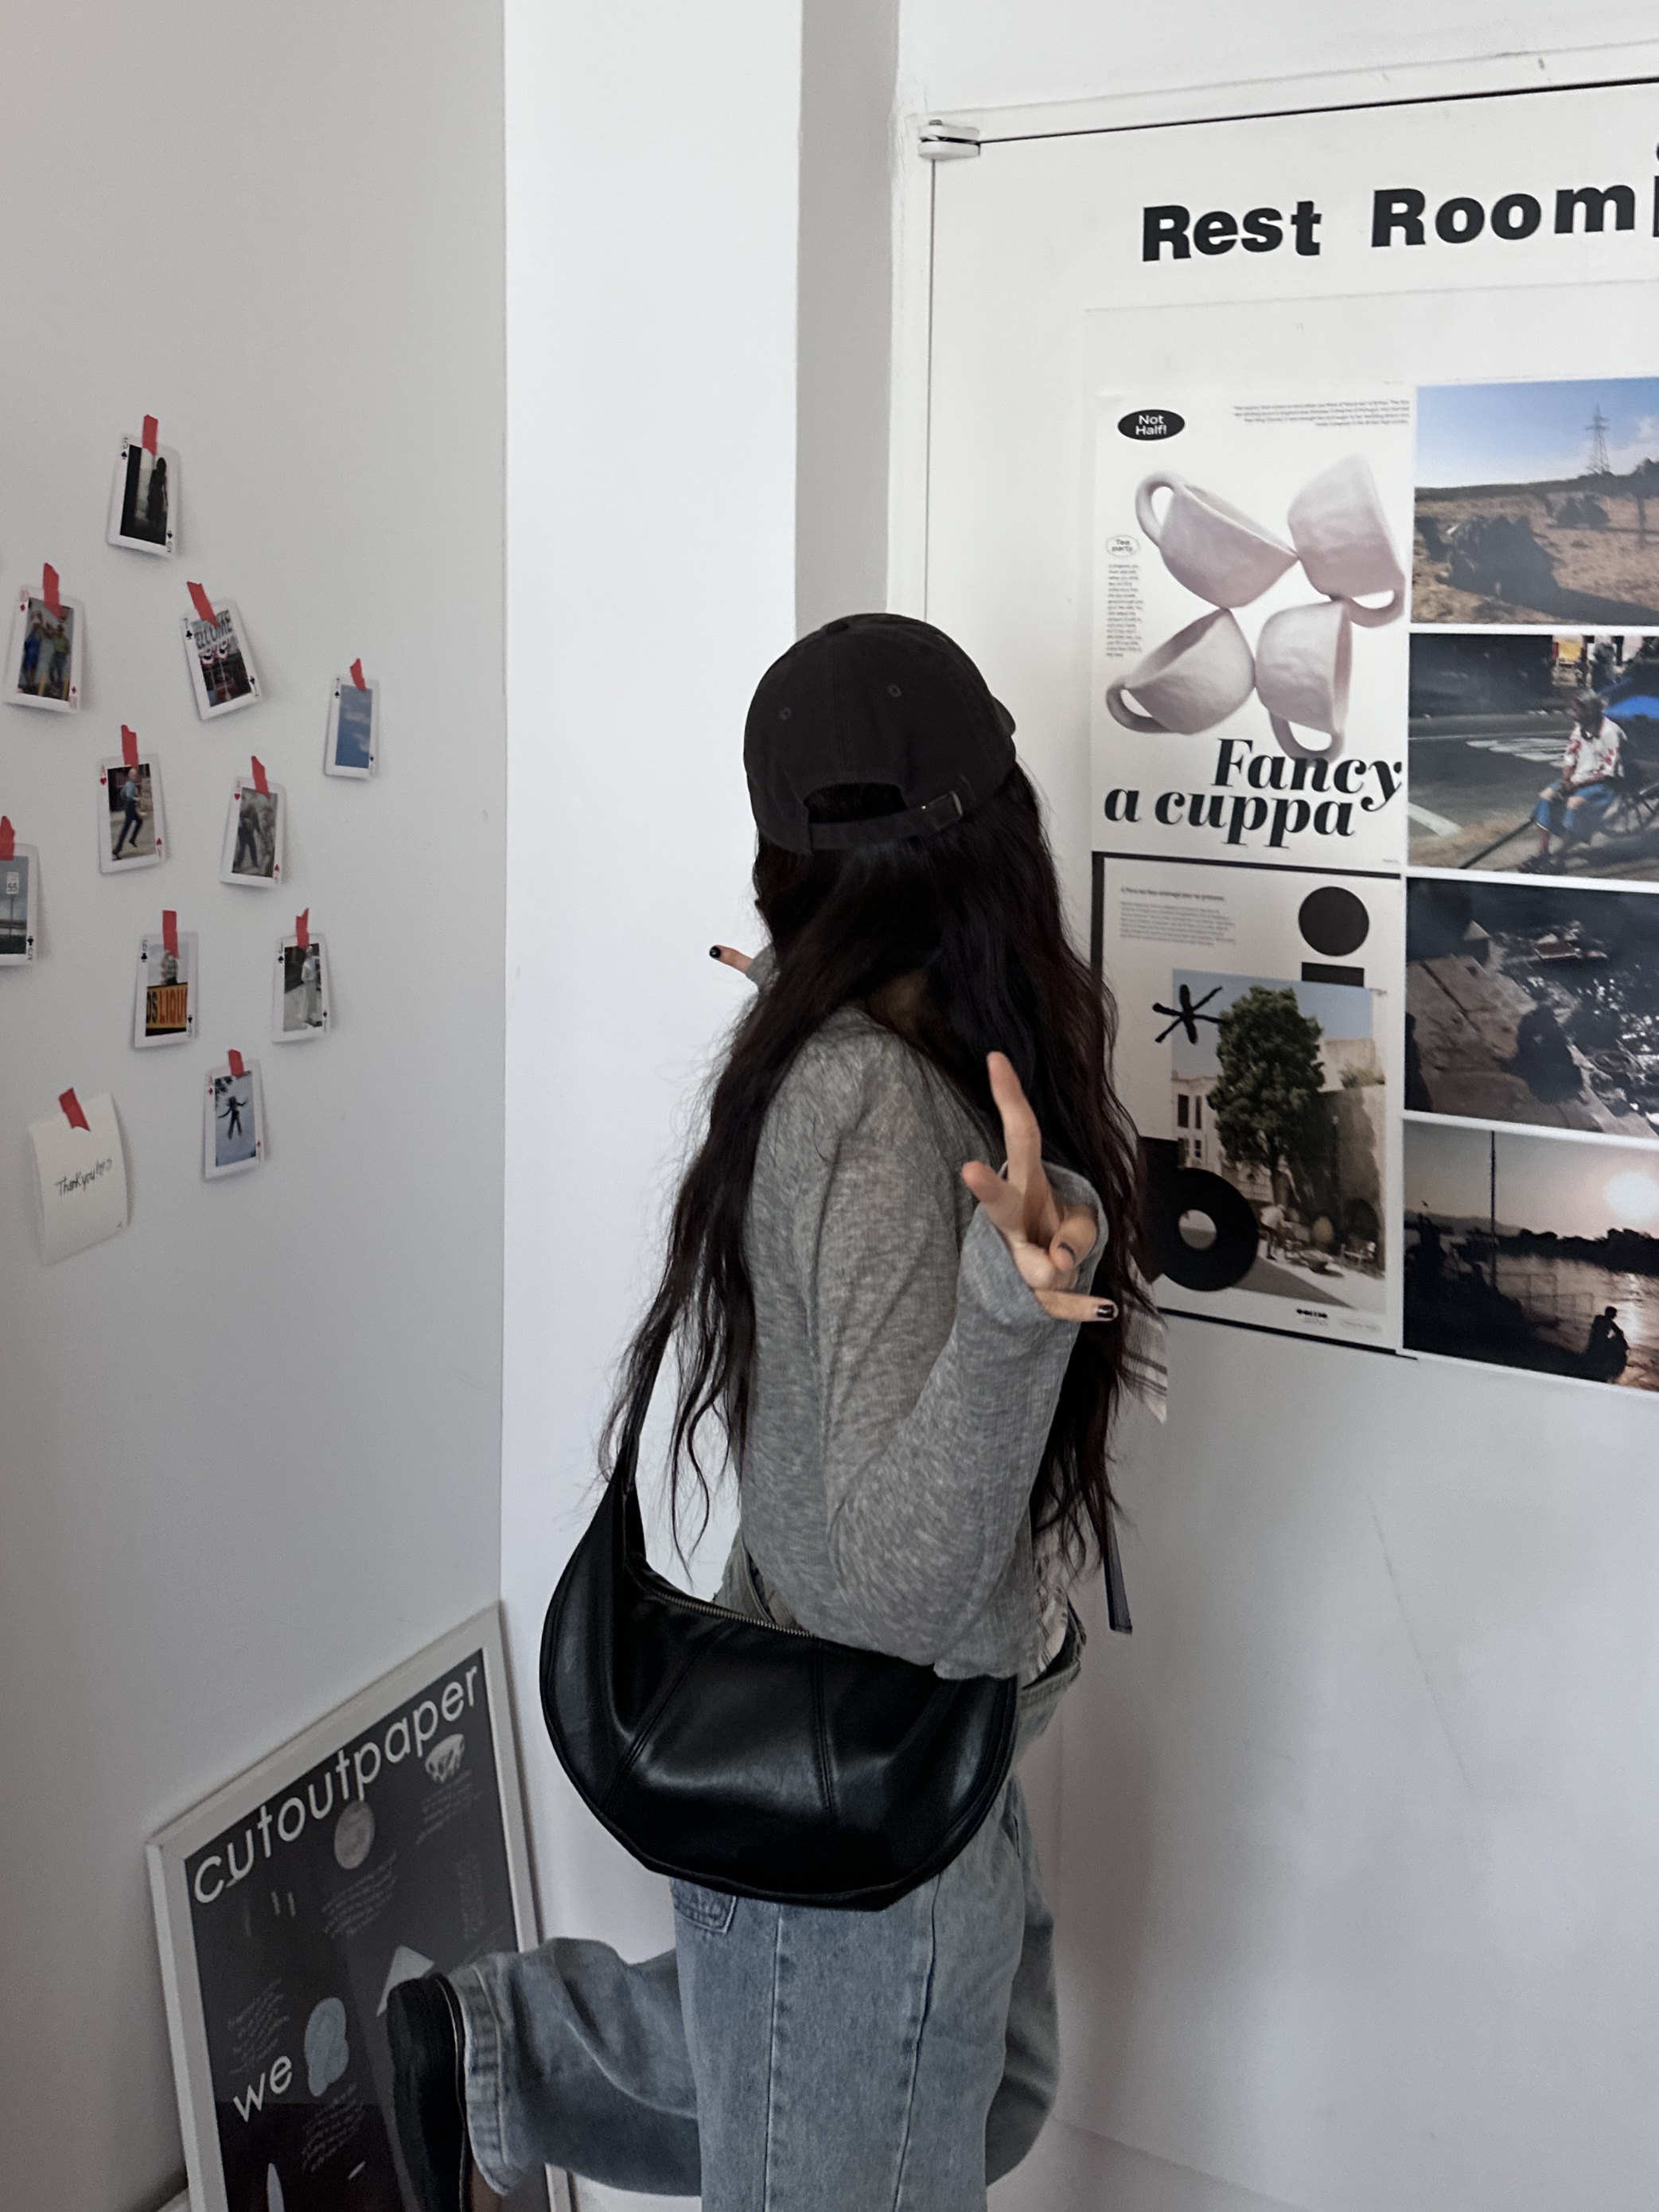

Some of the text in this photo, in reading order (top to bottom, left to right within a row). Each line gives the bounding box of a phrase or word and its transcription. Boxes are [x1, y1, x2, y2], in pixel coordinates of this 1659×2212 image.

[1142, 185, 1635, 262] Rest Room
[1139, 415, 1164, 425] Not
[1210, 738, 1402, 812] Fancy
[1104, 789, 1355, 848] a cuppa
[194, 1666, 477, 1903] cutoutpaper
[233, 2055, 292, 2123] we
